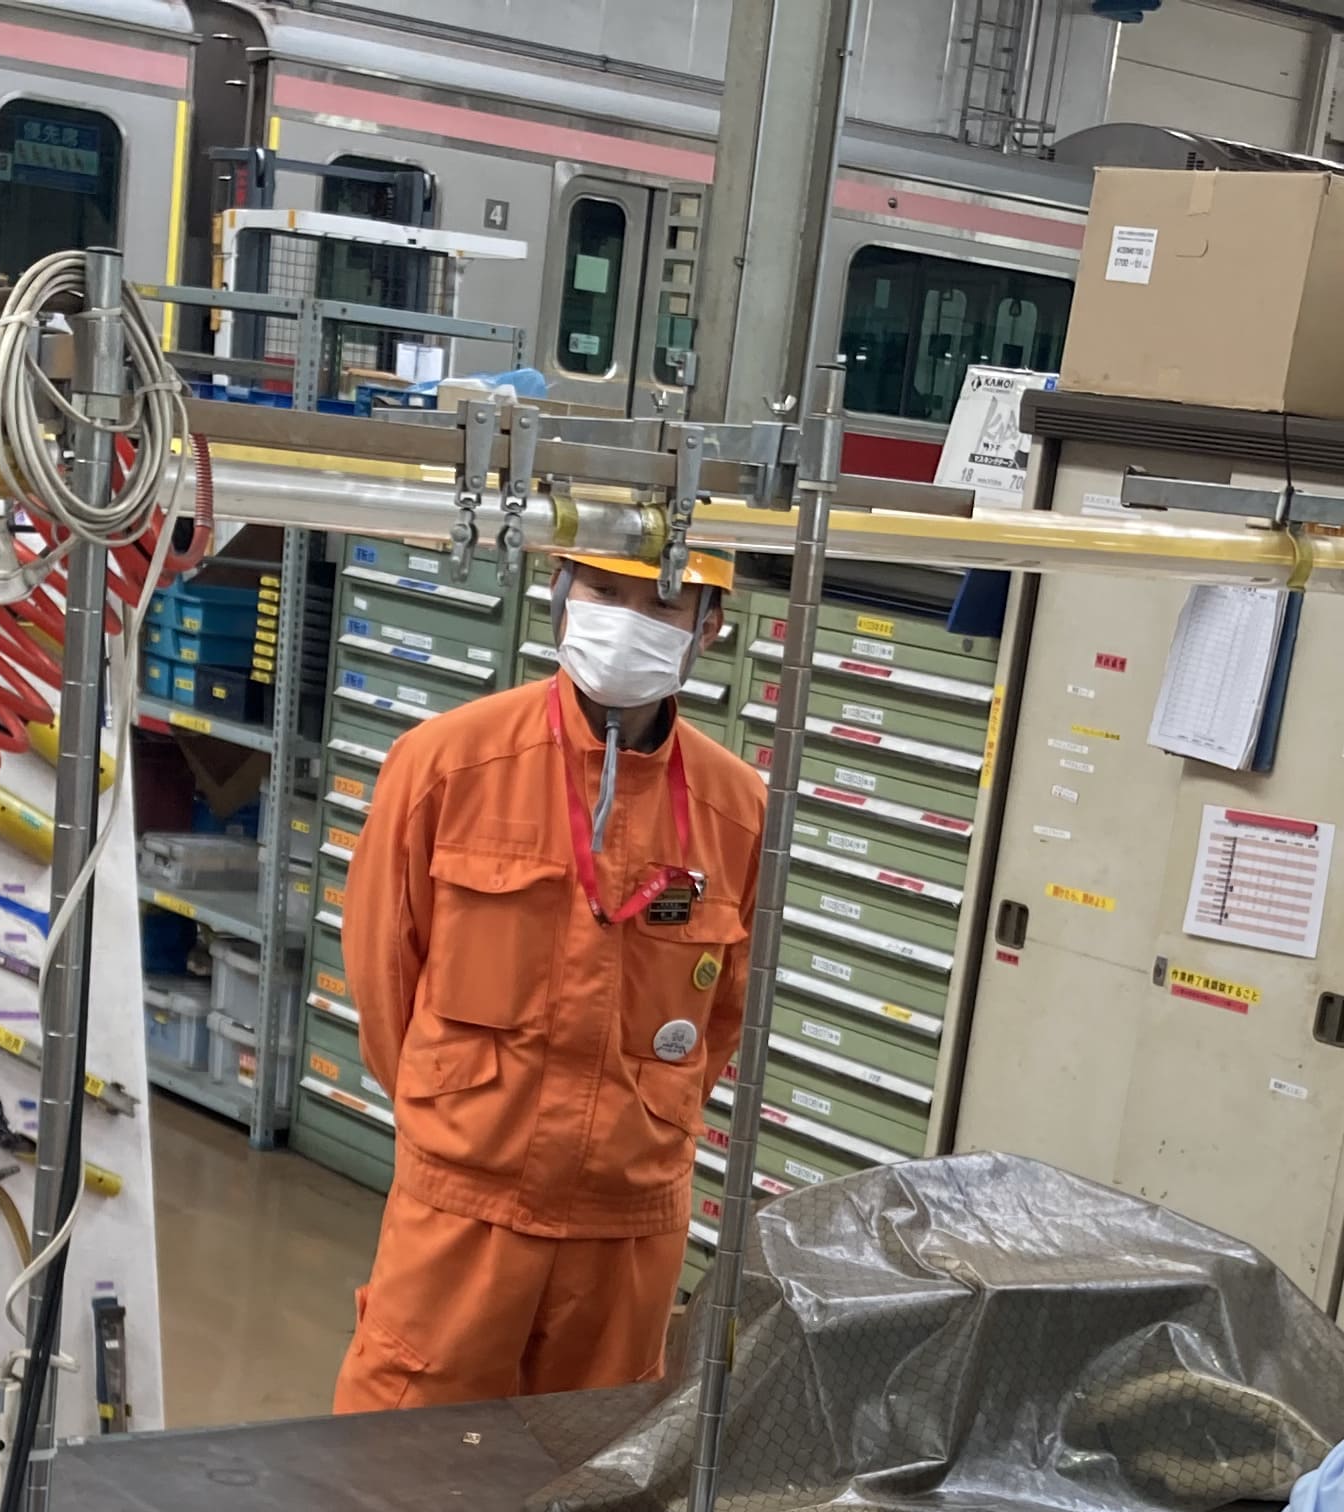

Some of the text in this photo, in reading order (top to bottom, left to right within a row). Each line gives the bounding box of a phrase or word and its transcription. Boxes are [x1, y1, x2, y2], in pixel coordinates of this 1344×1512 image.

[489, 204, 504, 226] 4
[984, 378, 1015, 390] KAMOI
[962, 467, 974, 482] 18
